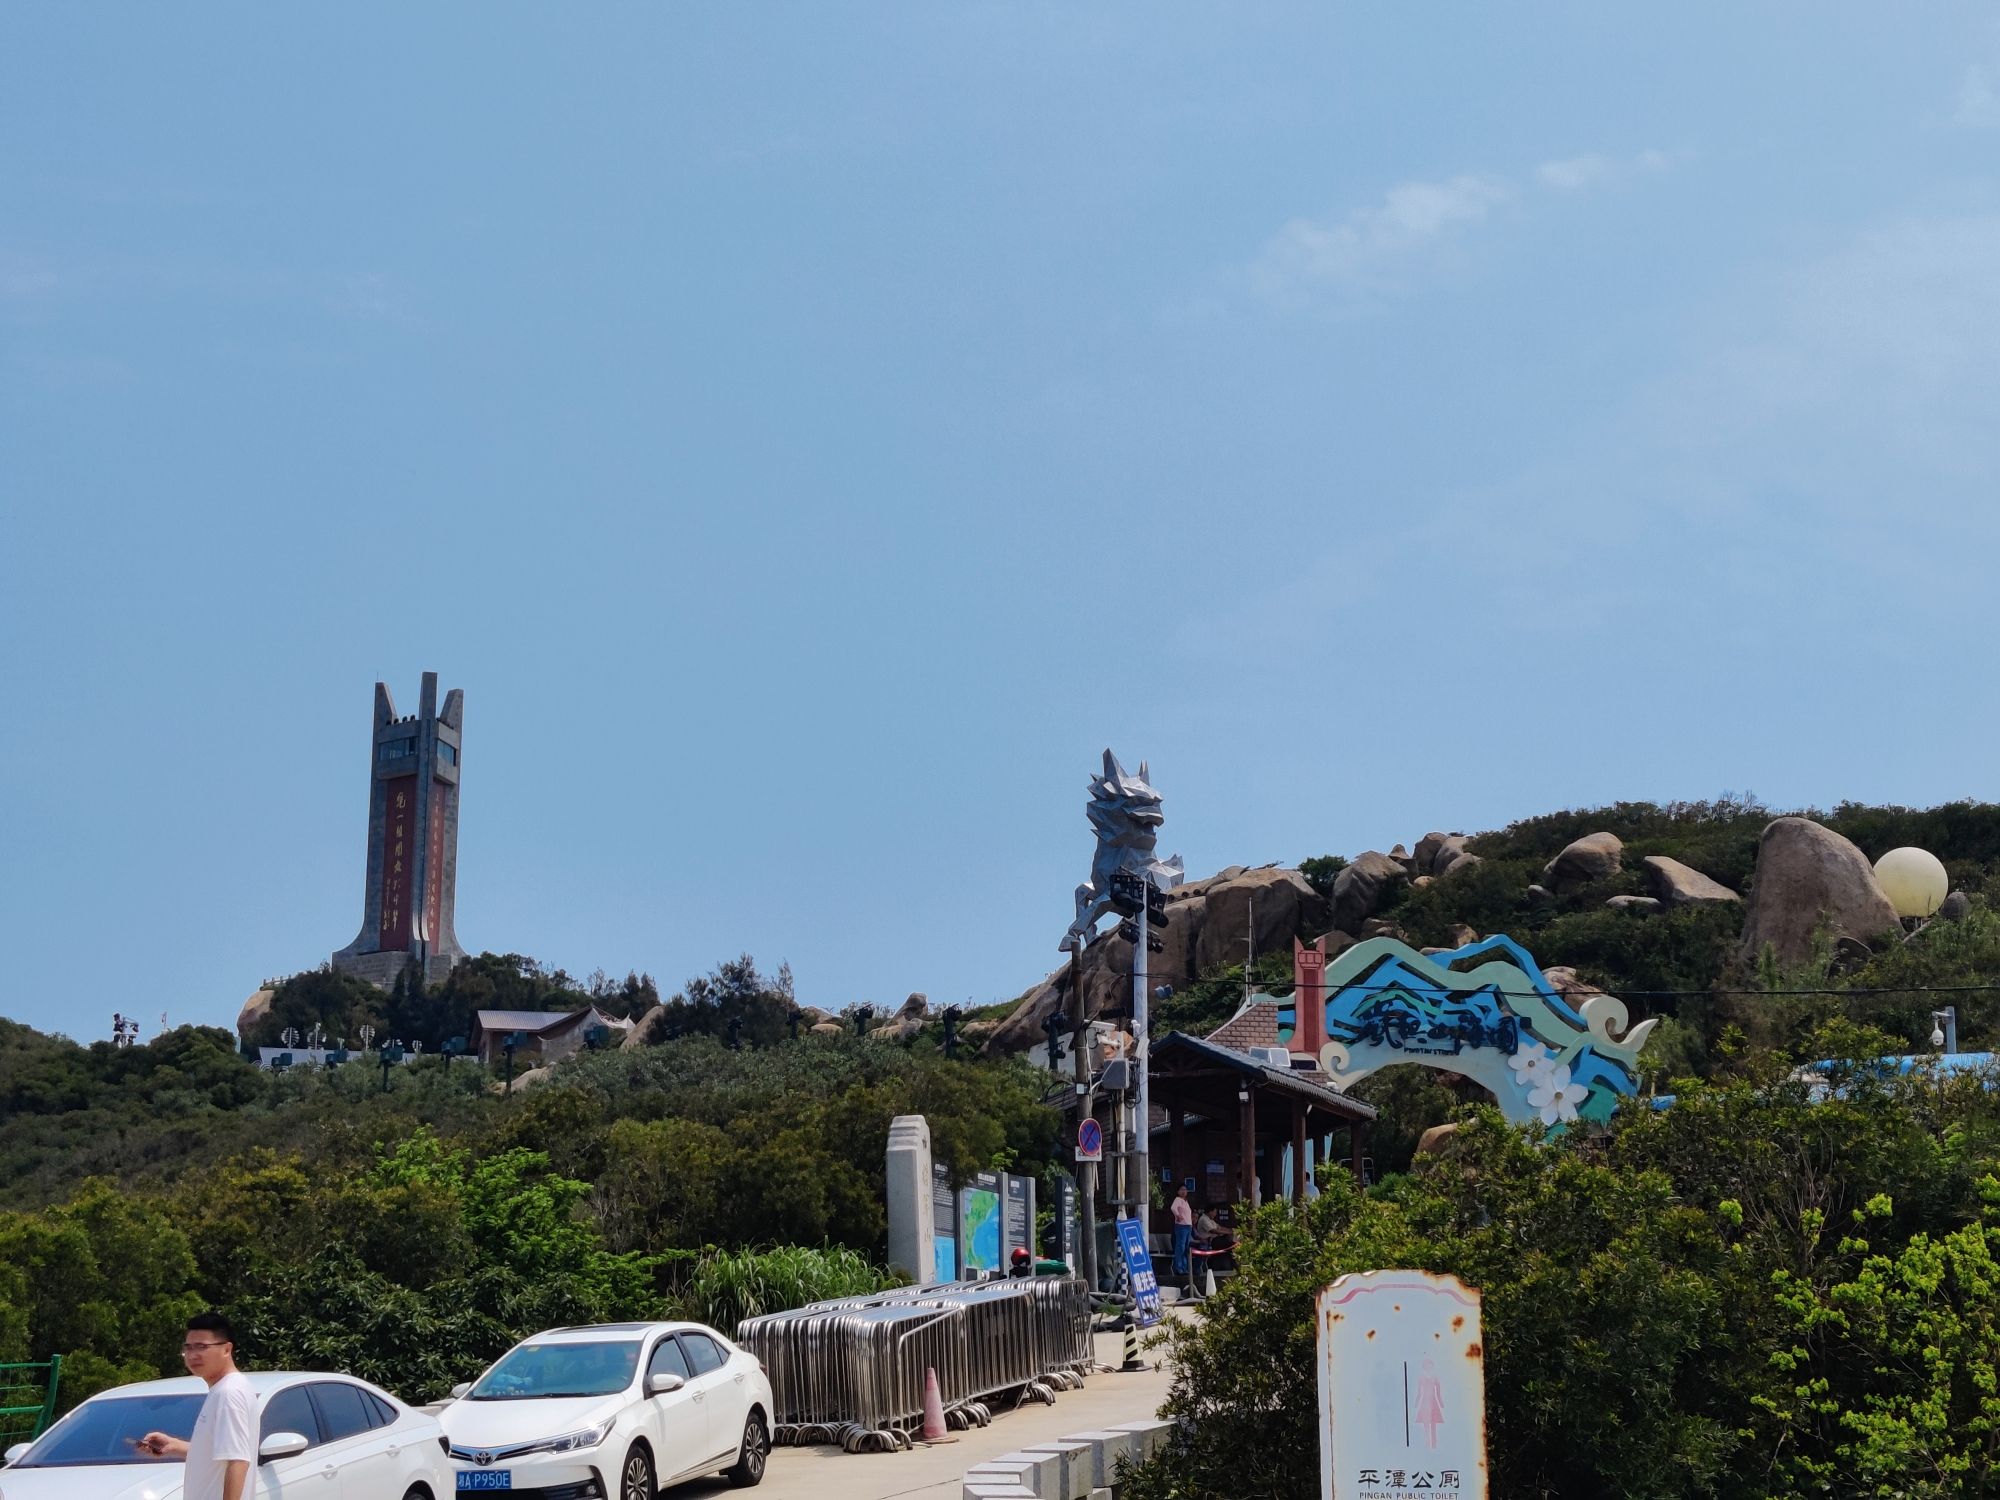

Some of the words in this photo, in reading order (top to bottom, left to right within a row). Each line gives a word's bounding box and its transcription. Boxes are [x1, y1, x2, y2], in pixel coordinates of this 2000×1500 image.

[1358, 1469, 1460, 1489] 平潭公厕
[1359, 1492, 1392, 1500] PINGAN
[1396, 1492, 1426, 1500] PUBLIC
[1431, 1492, 1459, 1500] TOILET
